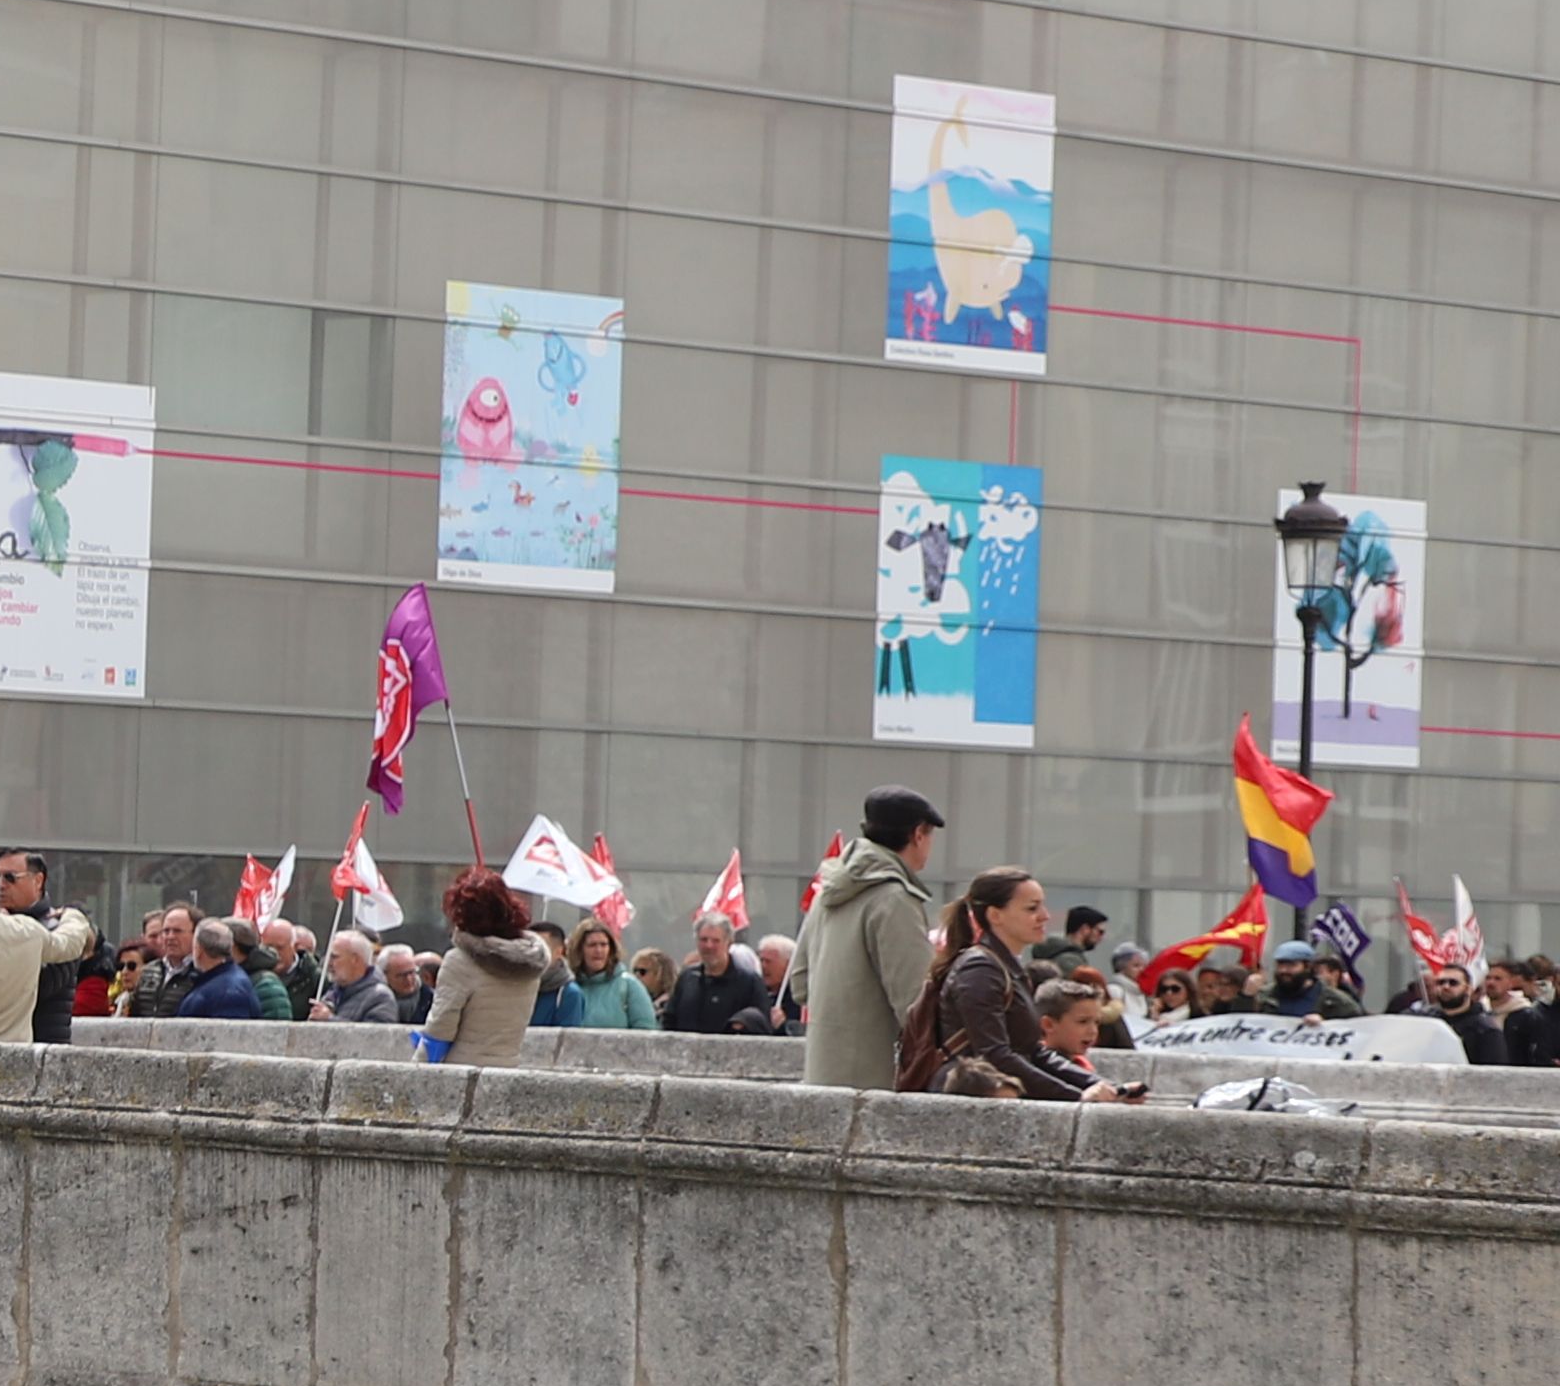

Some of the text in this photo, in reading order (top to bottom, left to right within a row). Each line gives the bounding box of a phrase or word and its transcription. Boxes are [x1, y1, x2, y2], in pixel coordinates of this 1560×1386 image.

[1, 601, 38, 613] cambiar
[1200, 1018, 1267, 1043] entre
[1269, 1024, 1354, 1046] clases
